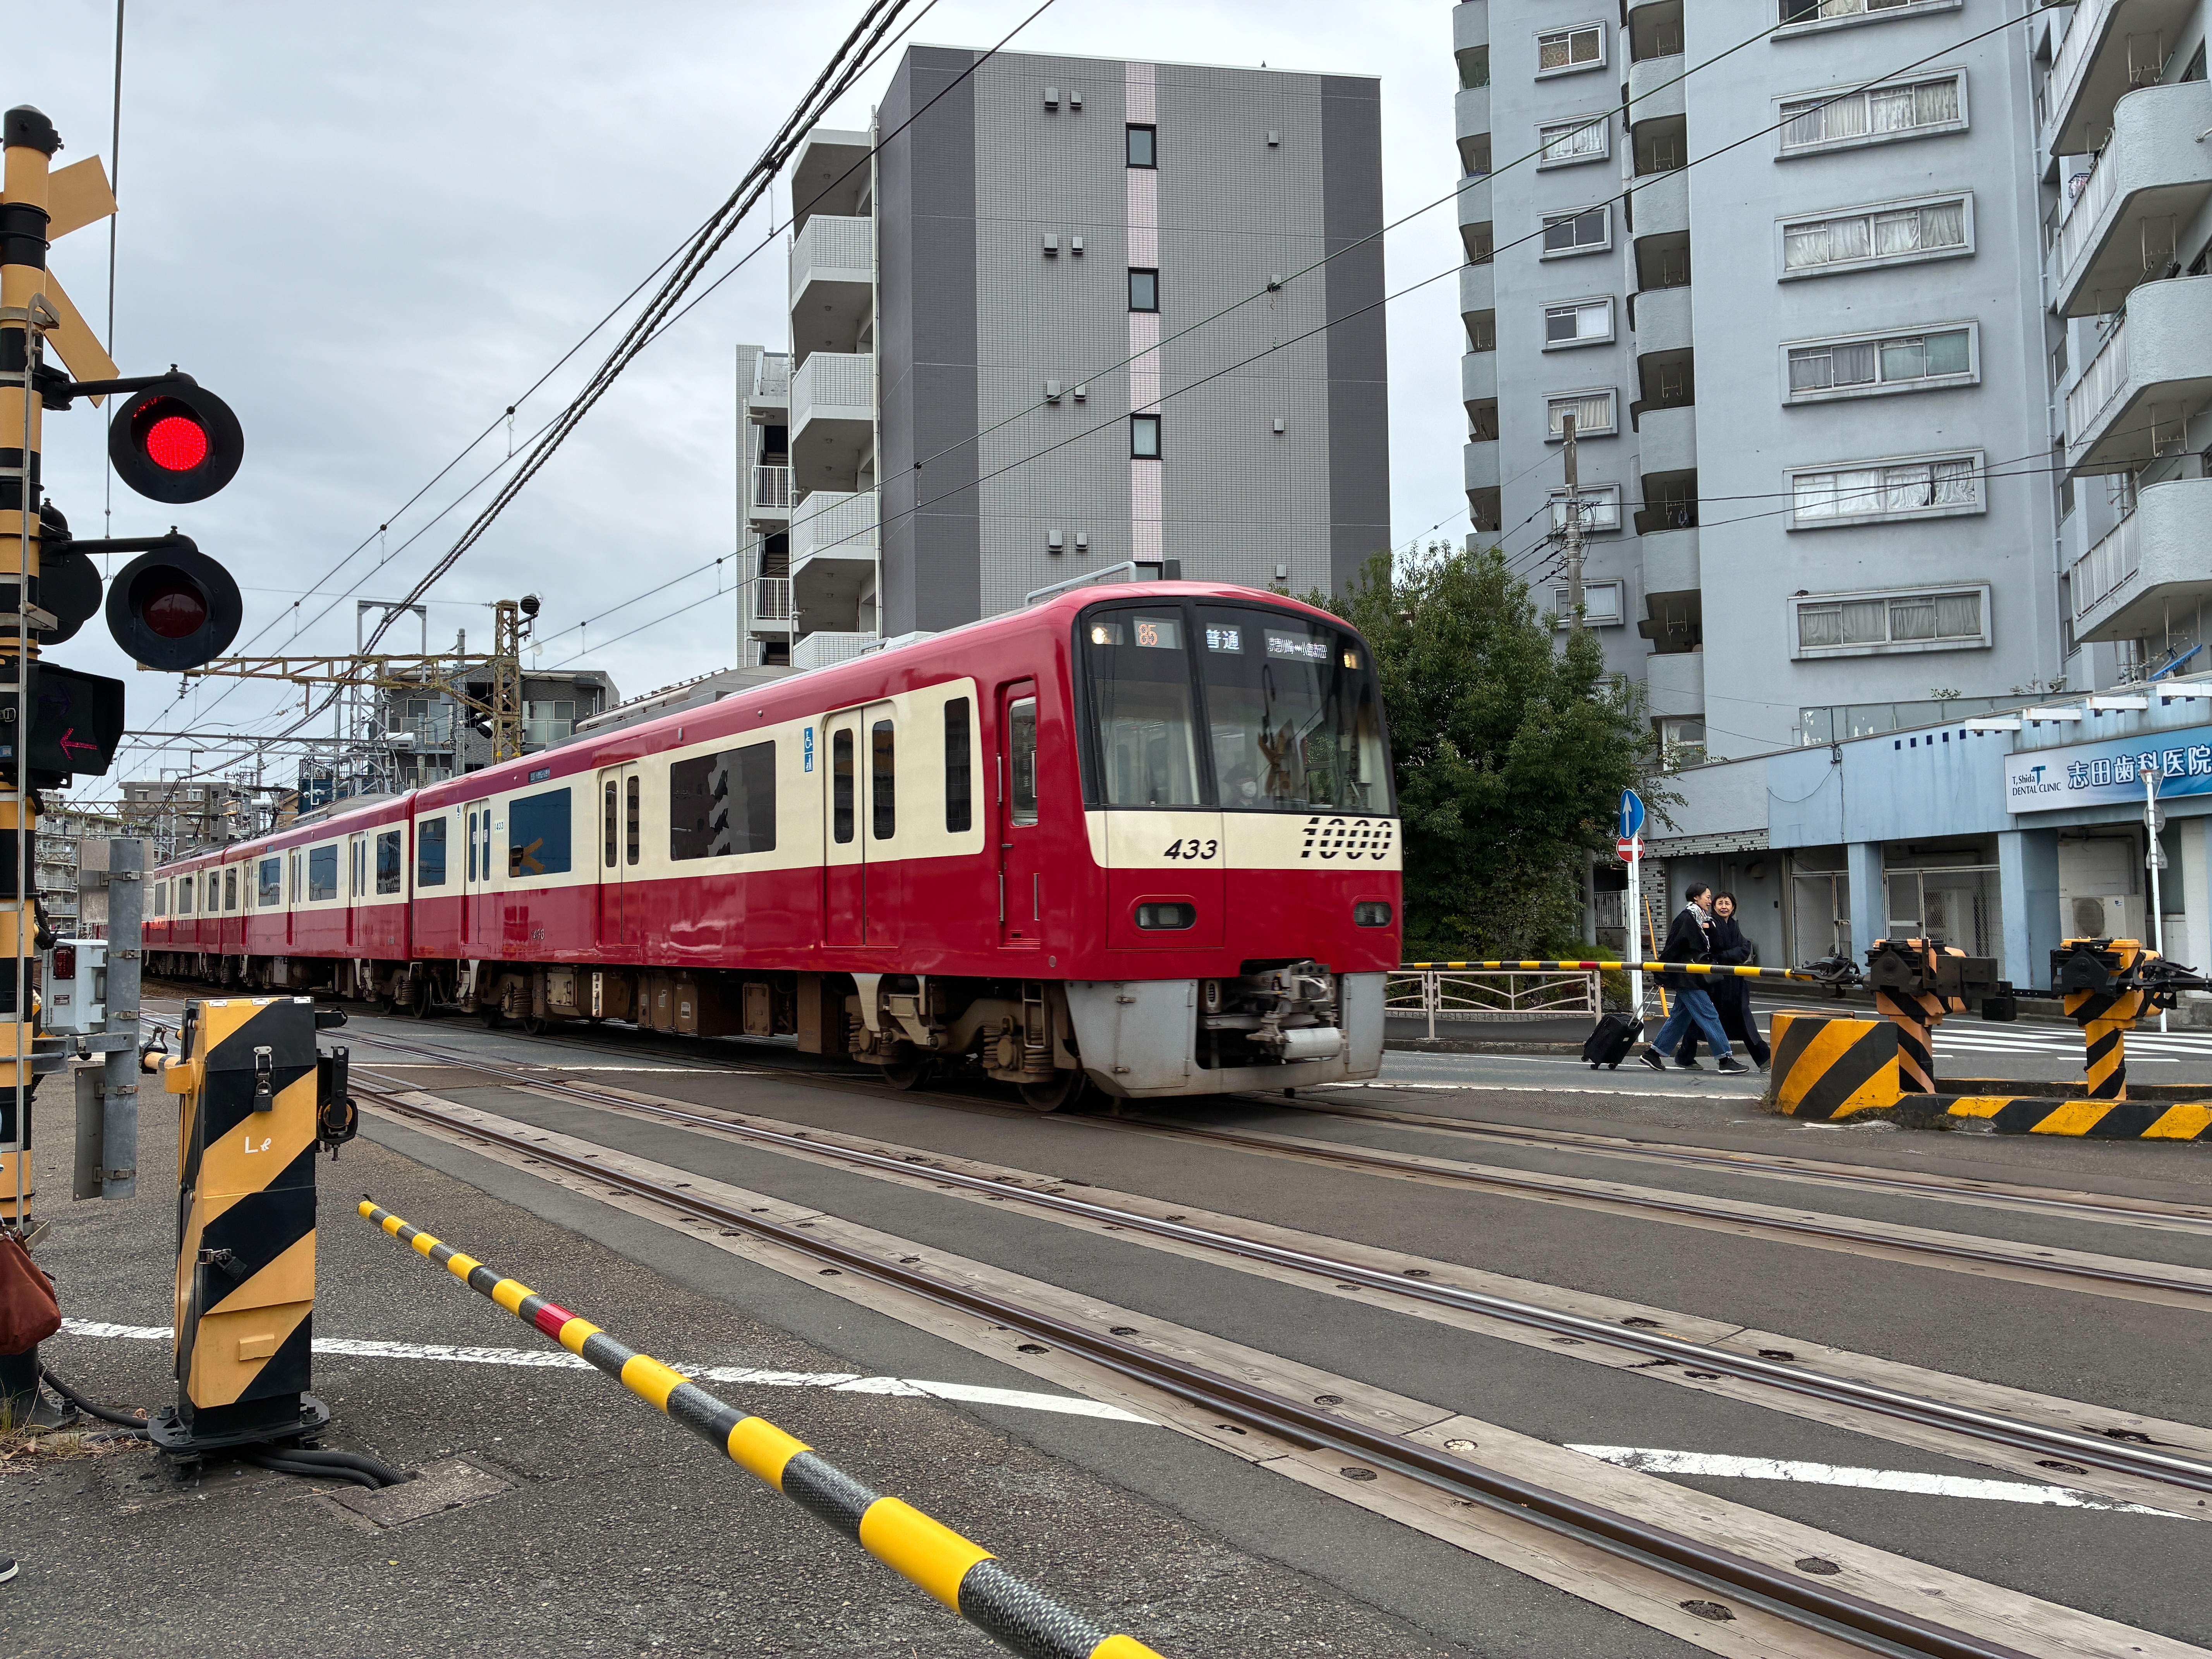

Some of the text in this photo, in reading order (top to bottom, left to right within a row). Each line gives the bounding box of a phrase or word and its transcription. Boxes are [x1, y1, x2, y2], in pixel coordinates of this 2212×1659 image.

[1206, 629, 1240, 650] 普通
[2067, 744, 2212, 789] 志田歯科医院
[2013, 782, 2061, 796] DENTAL CLINIC
[1300, 817, 1393, 860] 1000
[1163, 839, 1218, 860] 433
